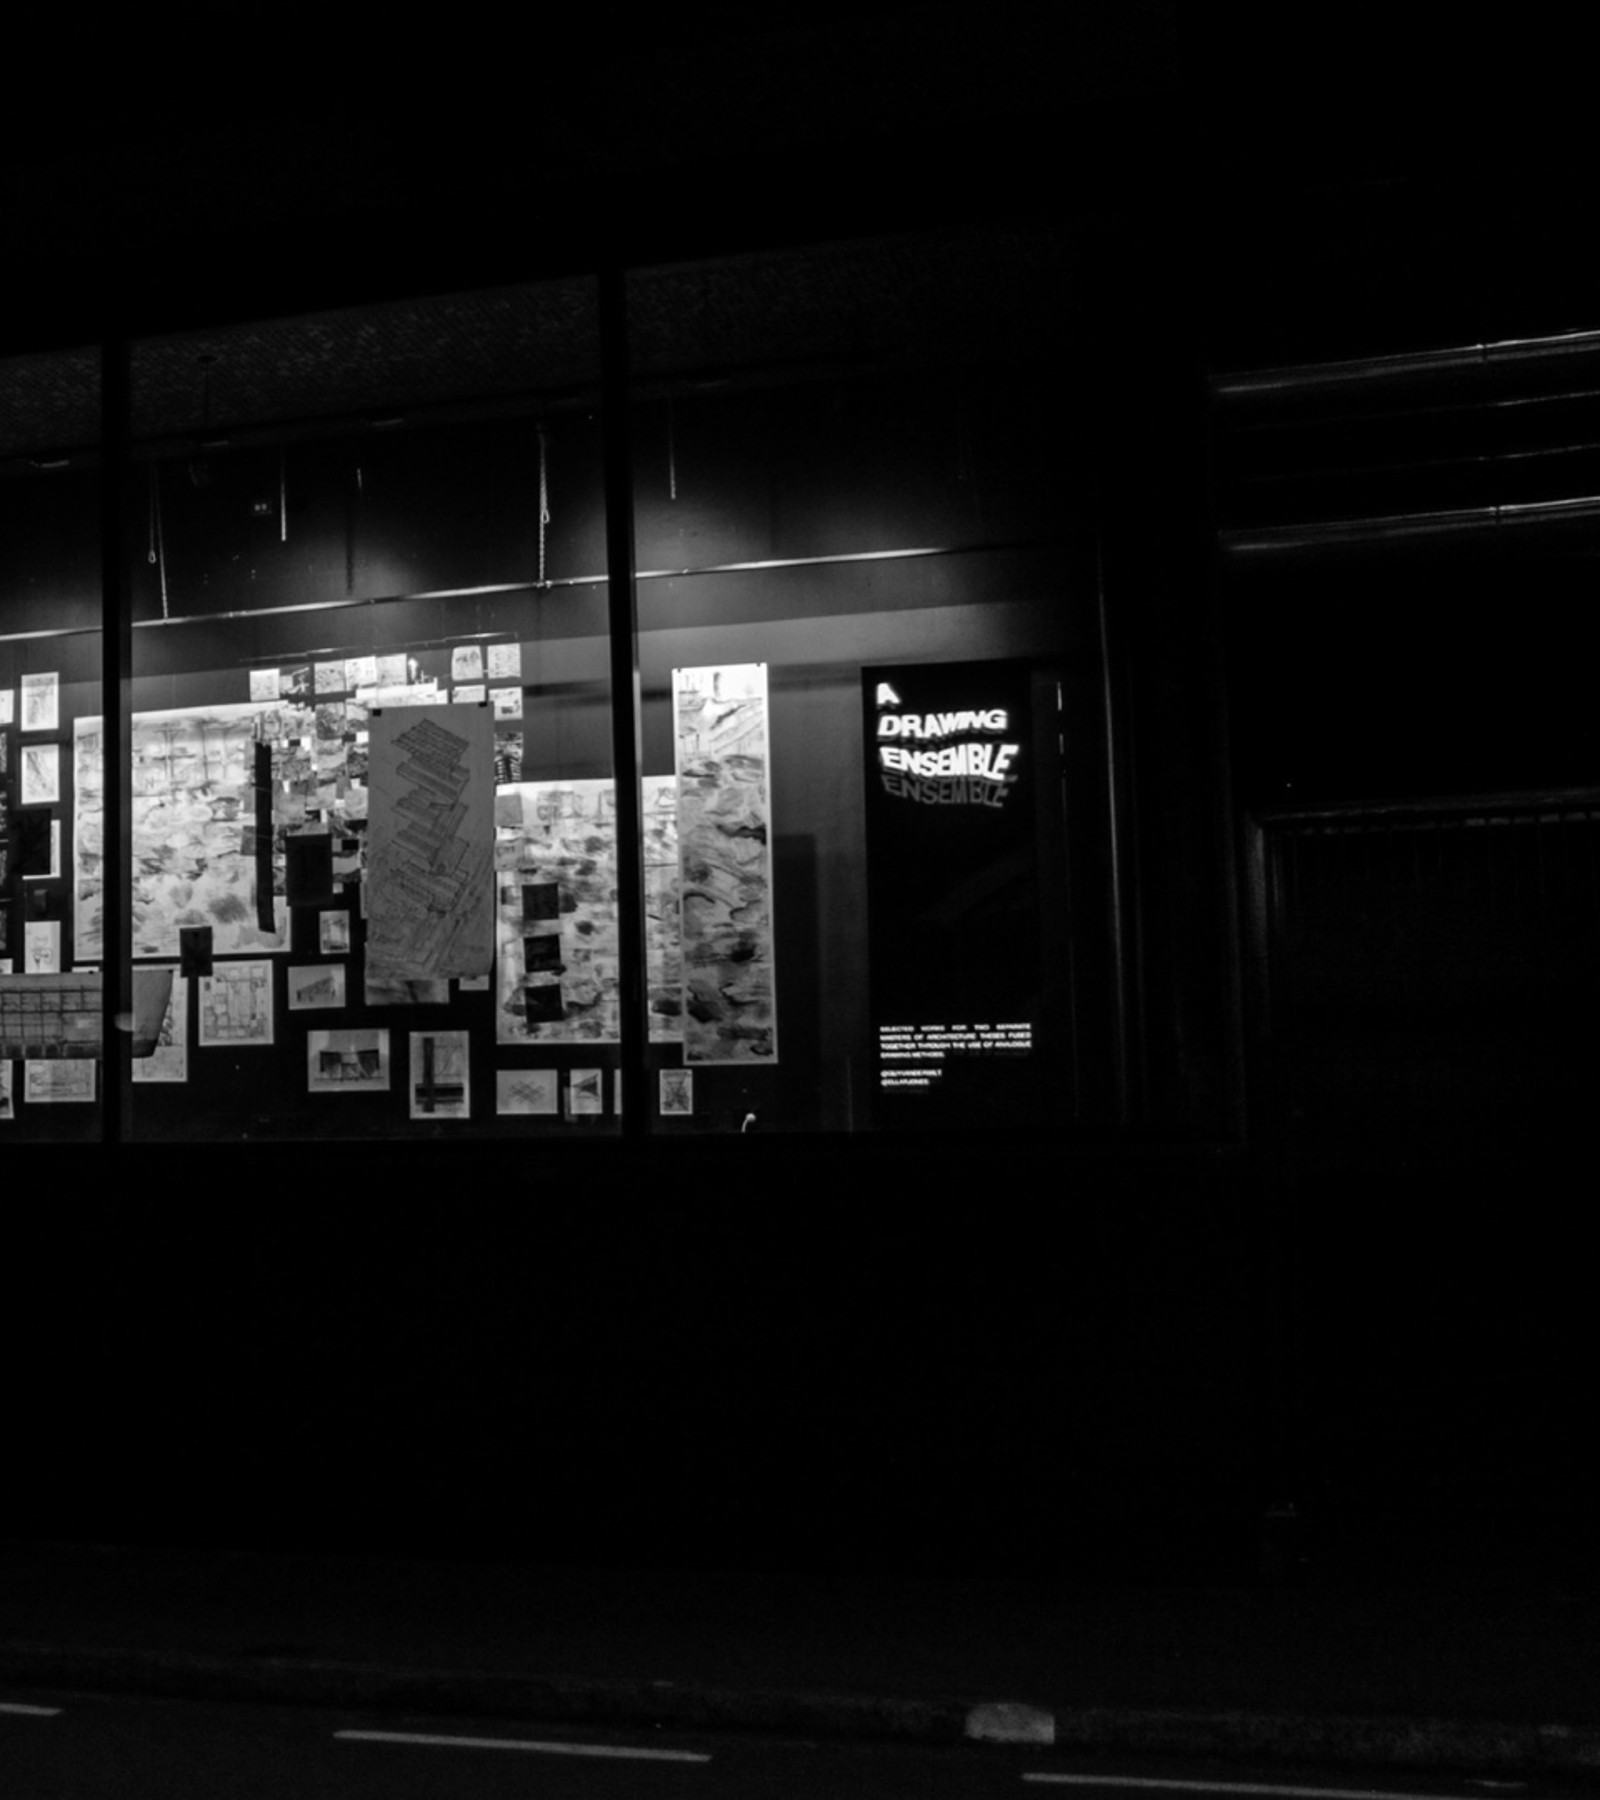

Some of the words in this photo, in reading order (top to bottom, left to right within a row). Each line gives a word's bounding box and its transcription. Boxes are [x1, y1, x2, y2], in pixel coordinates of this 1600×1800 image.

[876, 682, 901, 705] A
[877, 709, 1008, 738] DRAWING
[879, 743, 1019, 781] ENSEMBLE
